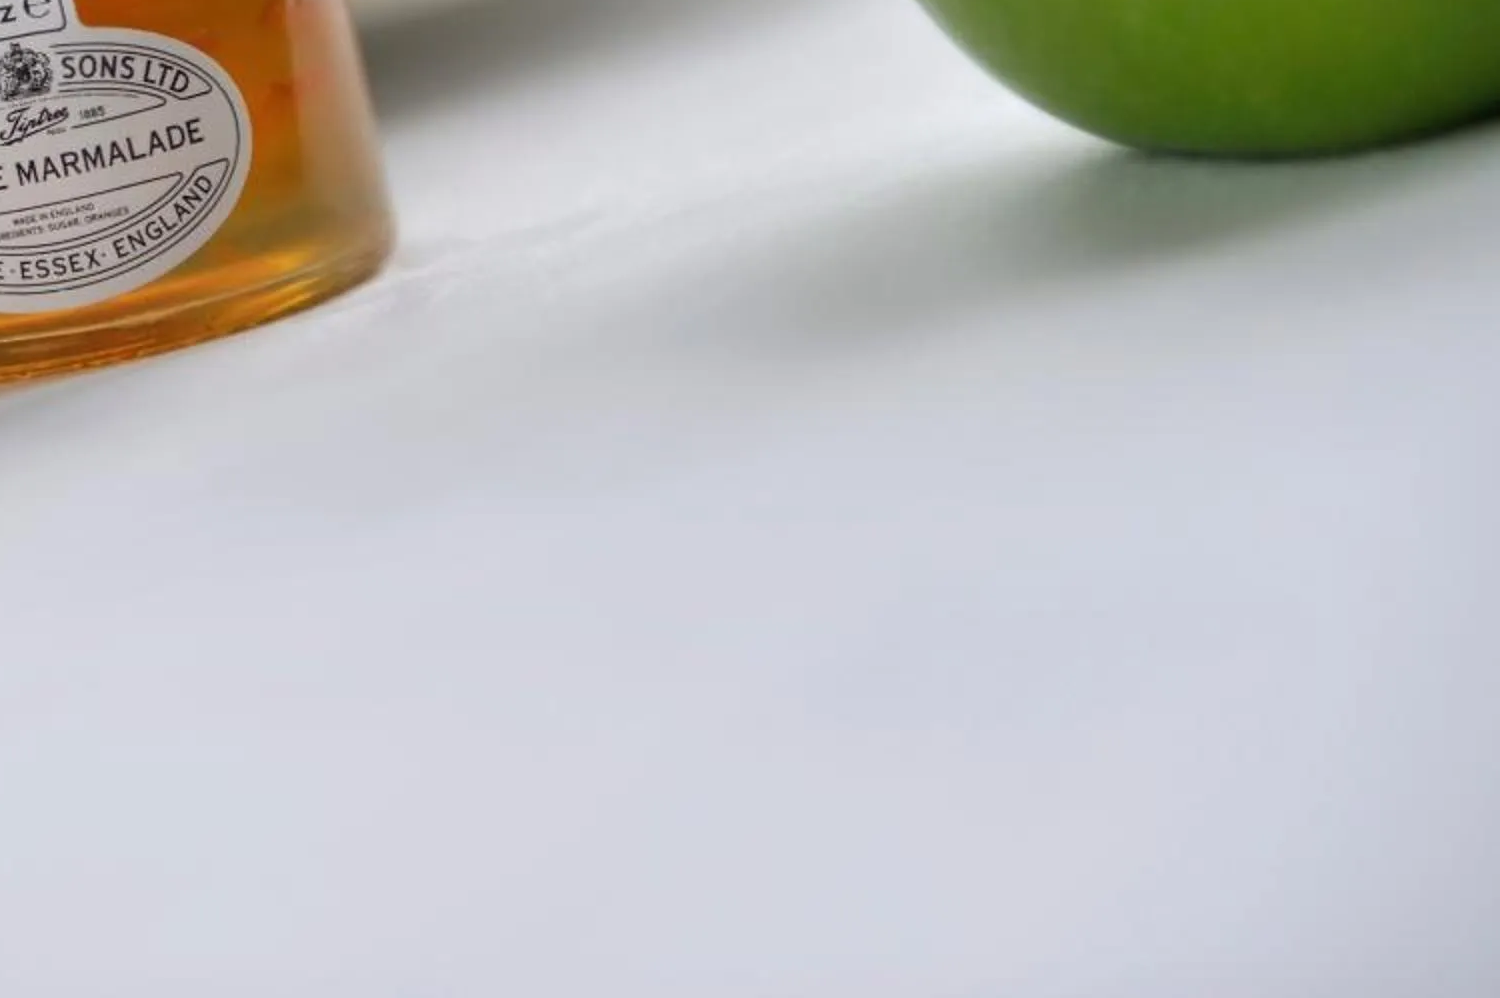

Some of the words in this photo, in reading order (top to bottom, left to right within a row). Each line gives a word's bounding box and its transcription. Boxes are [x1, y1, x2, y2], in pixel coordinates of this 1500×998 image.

[61, 54, 135, 80] SONS
[143, 58, 191, 94] LTD
[0, 105, 70, 147] Tiptree
[16, 117, 205, 188] MARMALADE
[19, 246, 103, 281] ESSEX
[112, 174, 214, 259] ENGLAND
